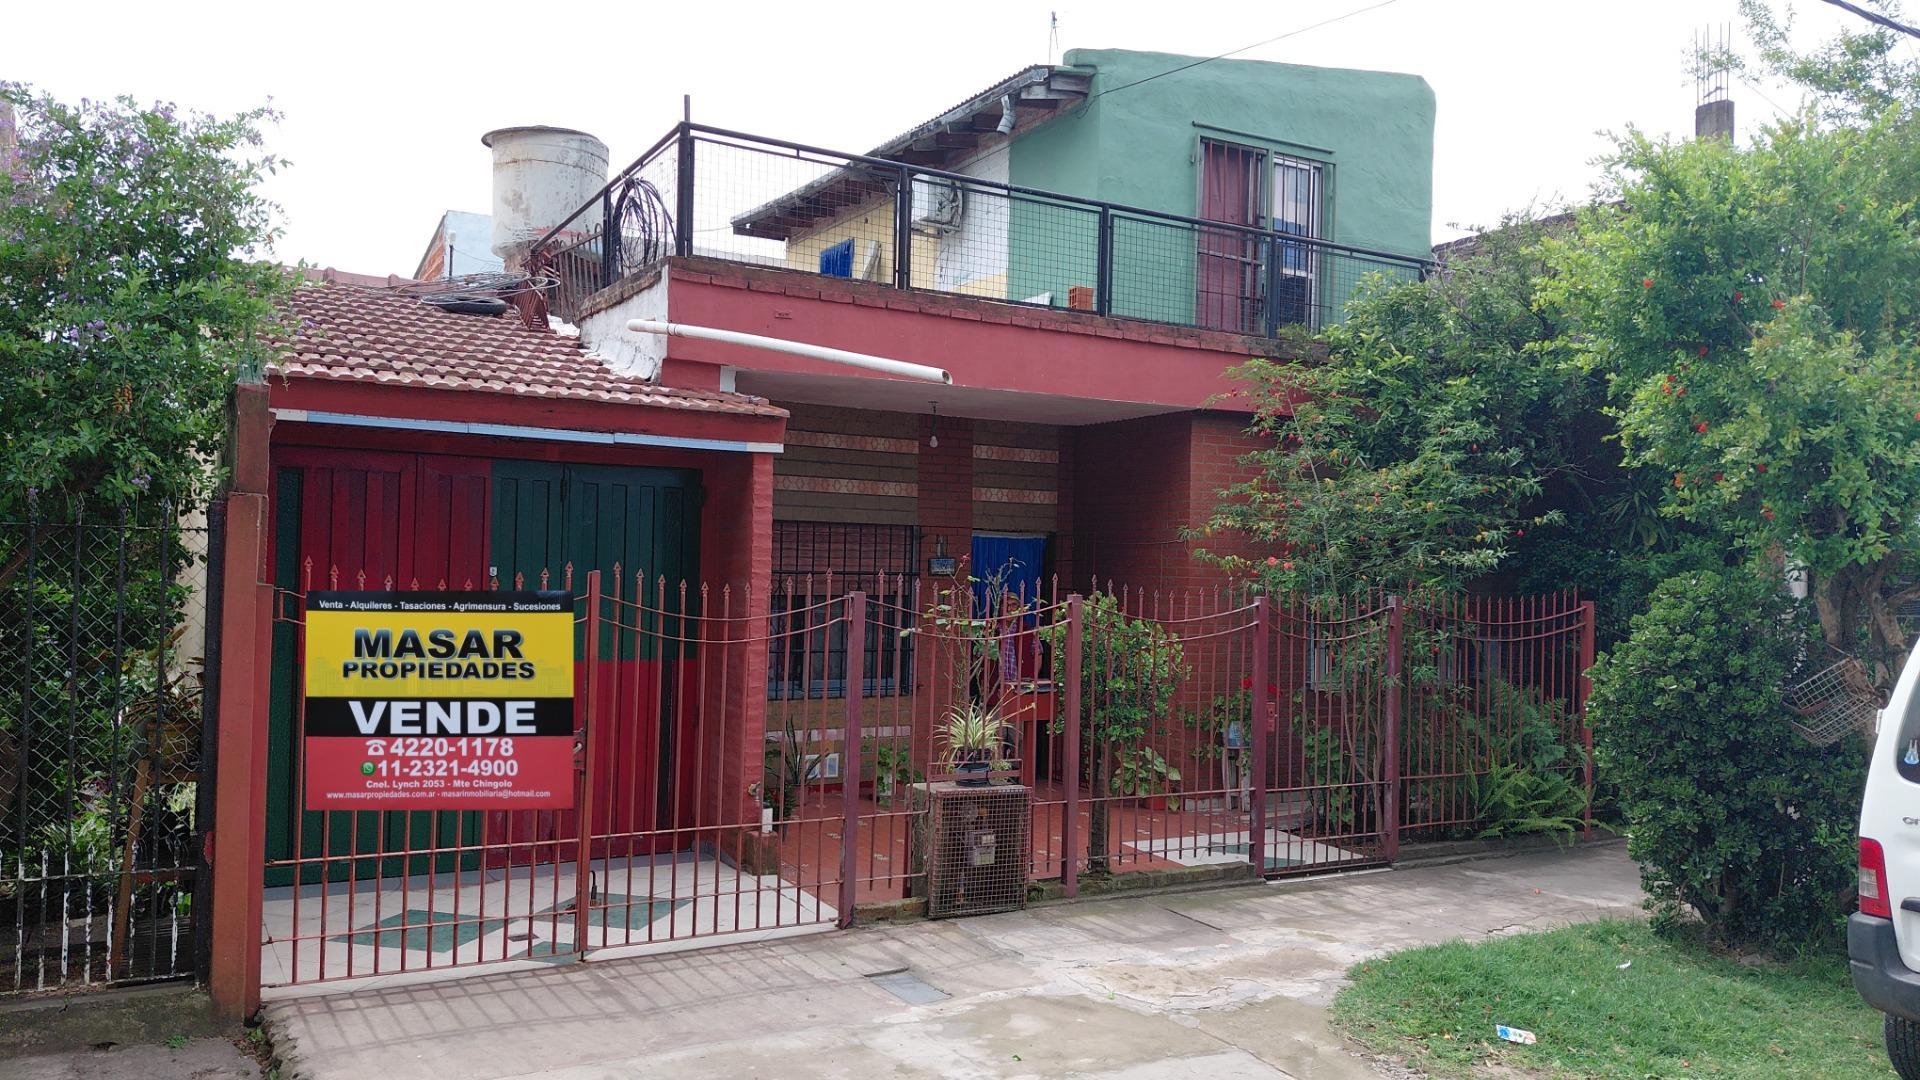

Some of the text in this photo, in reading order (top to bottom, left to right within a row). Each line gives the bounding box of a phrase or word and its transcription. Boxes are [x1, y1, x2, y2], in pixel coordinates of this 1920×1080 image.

[319, 600, 343, 609] Venta
[350, 601, 392, 611] Alquileres
[400, 601, 446, 610] Tasaciones
[453, 602, 506, 612] Agrimensura
[513, 602, 561, 611] Sucesiones
[353, 628, 525, 660] MASAR
[343, 661, 536, 679] PROPIEDADES
[348, 700, 537, 735] VENDE
[390, 737, 514, 757] 4220-1178
[377, 759, 519, 777] 11-2321-4900
[366, 780, 390, 788] Cnel.
[392, 780, 420, 789] Lynch
[422, 780, 445, 788] 2053
[453, 780, 470, 788] Mte
[472, 780, 513, 789] Chingolo
[326, 791, 435, 799] www.masarpropiedades.com.ar
[441, 790, 551, 798] masarinmobiliaria@hotmail.com
